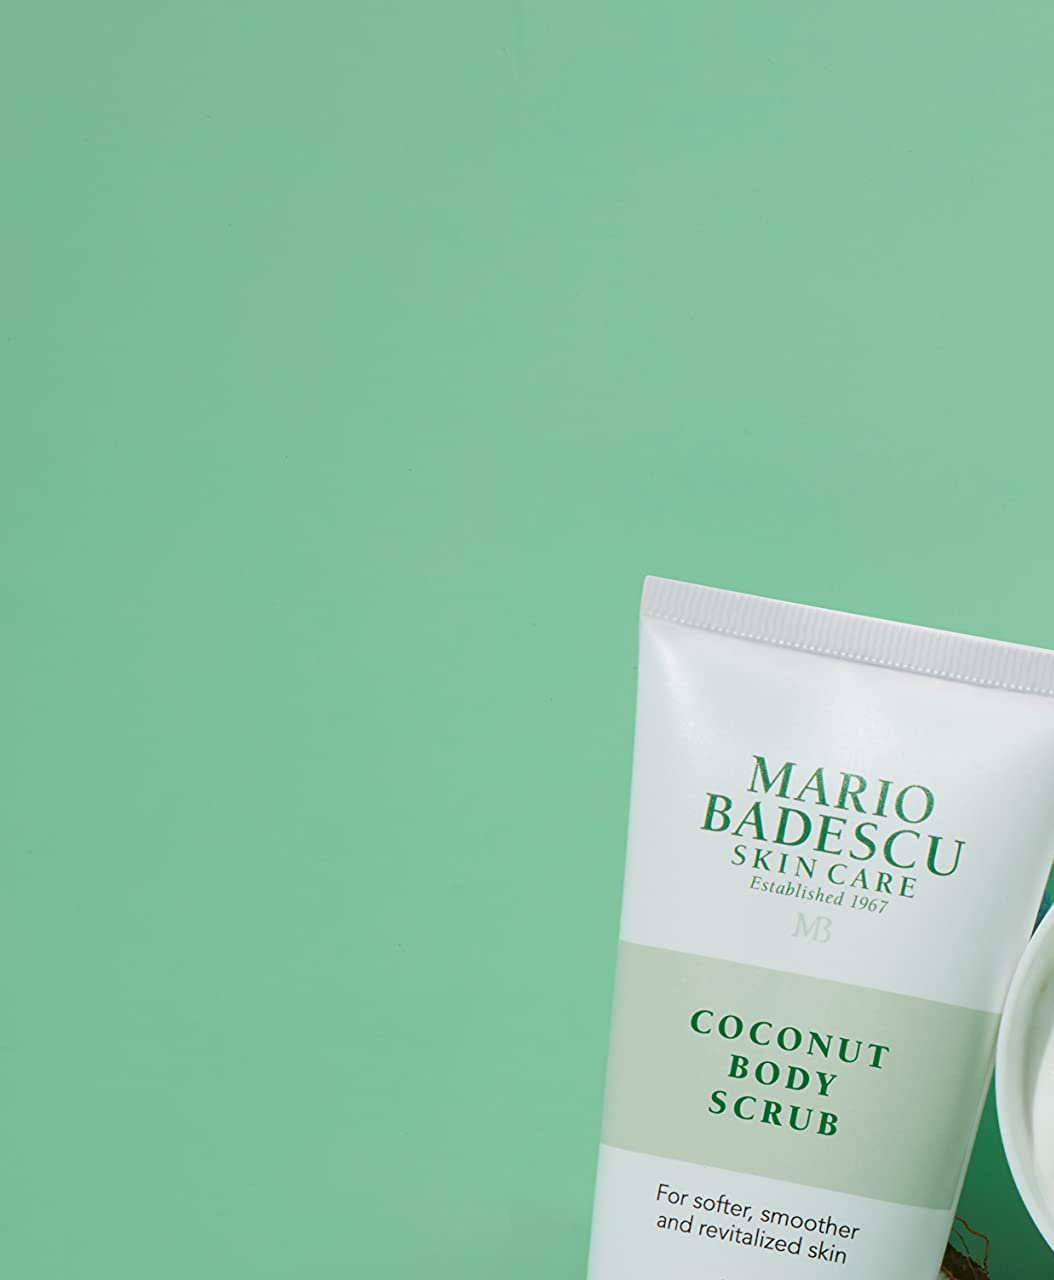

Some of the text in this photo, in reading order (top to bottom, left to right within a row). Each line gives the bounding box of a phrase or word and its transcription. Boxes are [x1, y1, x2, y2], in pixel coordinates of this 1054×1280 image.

[747, 755, 935, 824] MARIO
[700, 793, 966, 876] BADESCU
[731, 844, 917, 898] SKIN CARE
[750, 876, 888, 913] Established 1967
[691, 1010, 890, 1069] COCONUT
[728, 1054, 837, 1096] BODY
[708, 1090, 838, 1136] SCRUB
[657, 1183, 860, 1239] For softer, smoother
[657, 1215, 847, 1266] and revitalized skin
